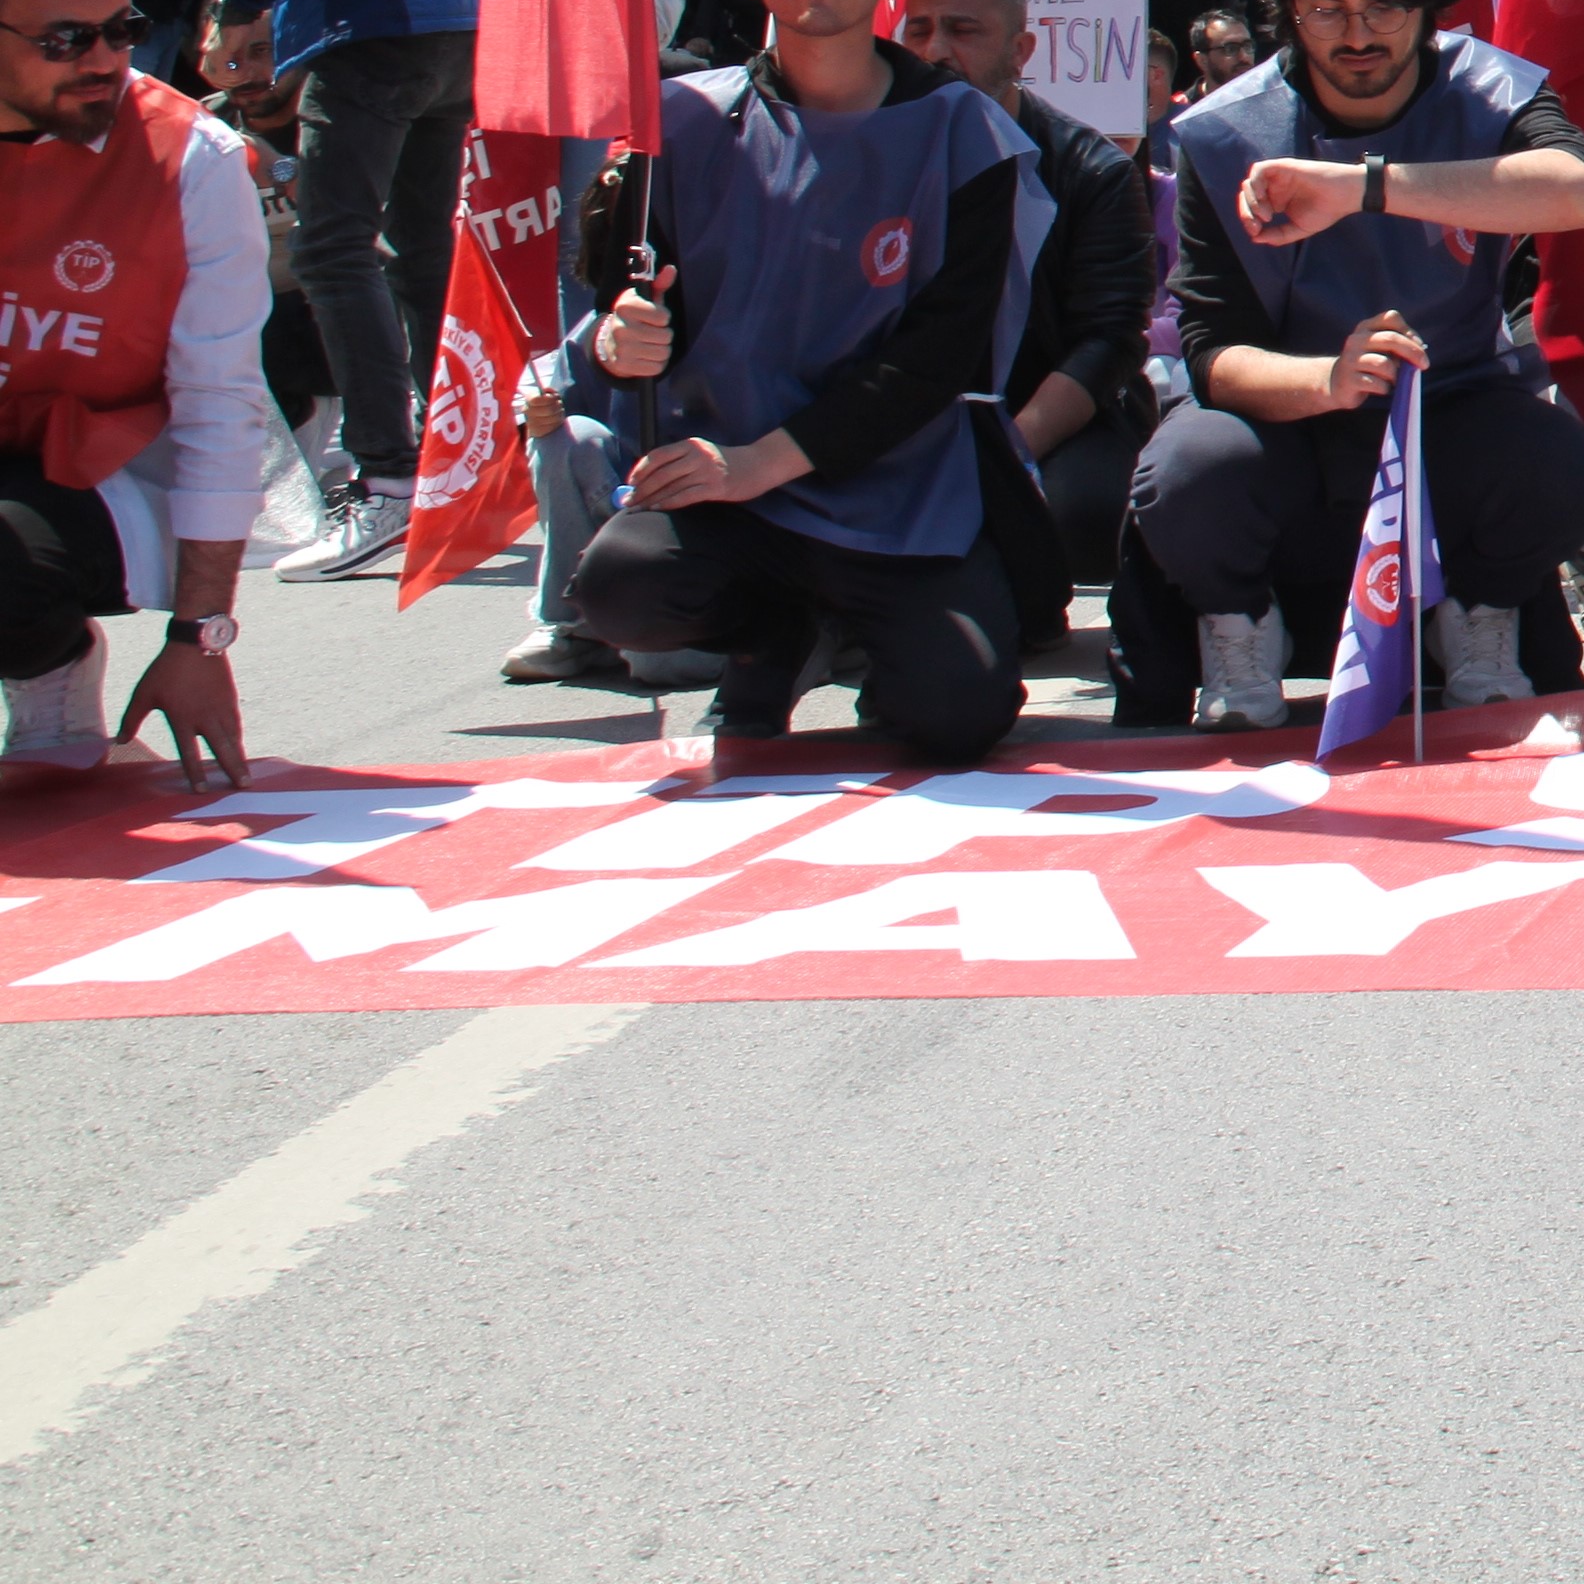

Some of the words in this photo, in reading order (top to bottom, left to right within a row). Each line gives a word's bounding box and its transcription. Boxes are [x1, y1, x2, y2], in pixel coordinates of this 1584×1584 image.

[1020, 16, 1141, 86] TSİN
[431, 356, 467, 445] TİP
[466, 406, 492, 477] PARTİSİ
[127, 762, 1331, 883] TİP
